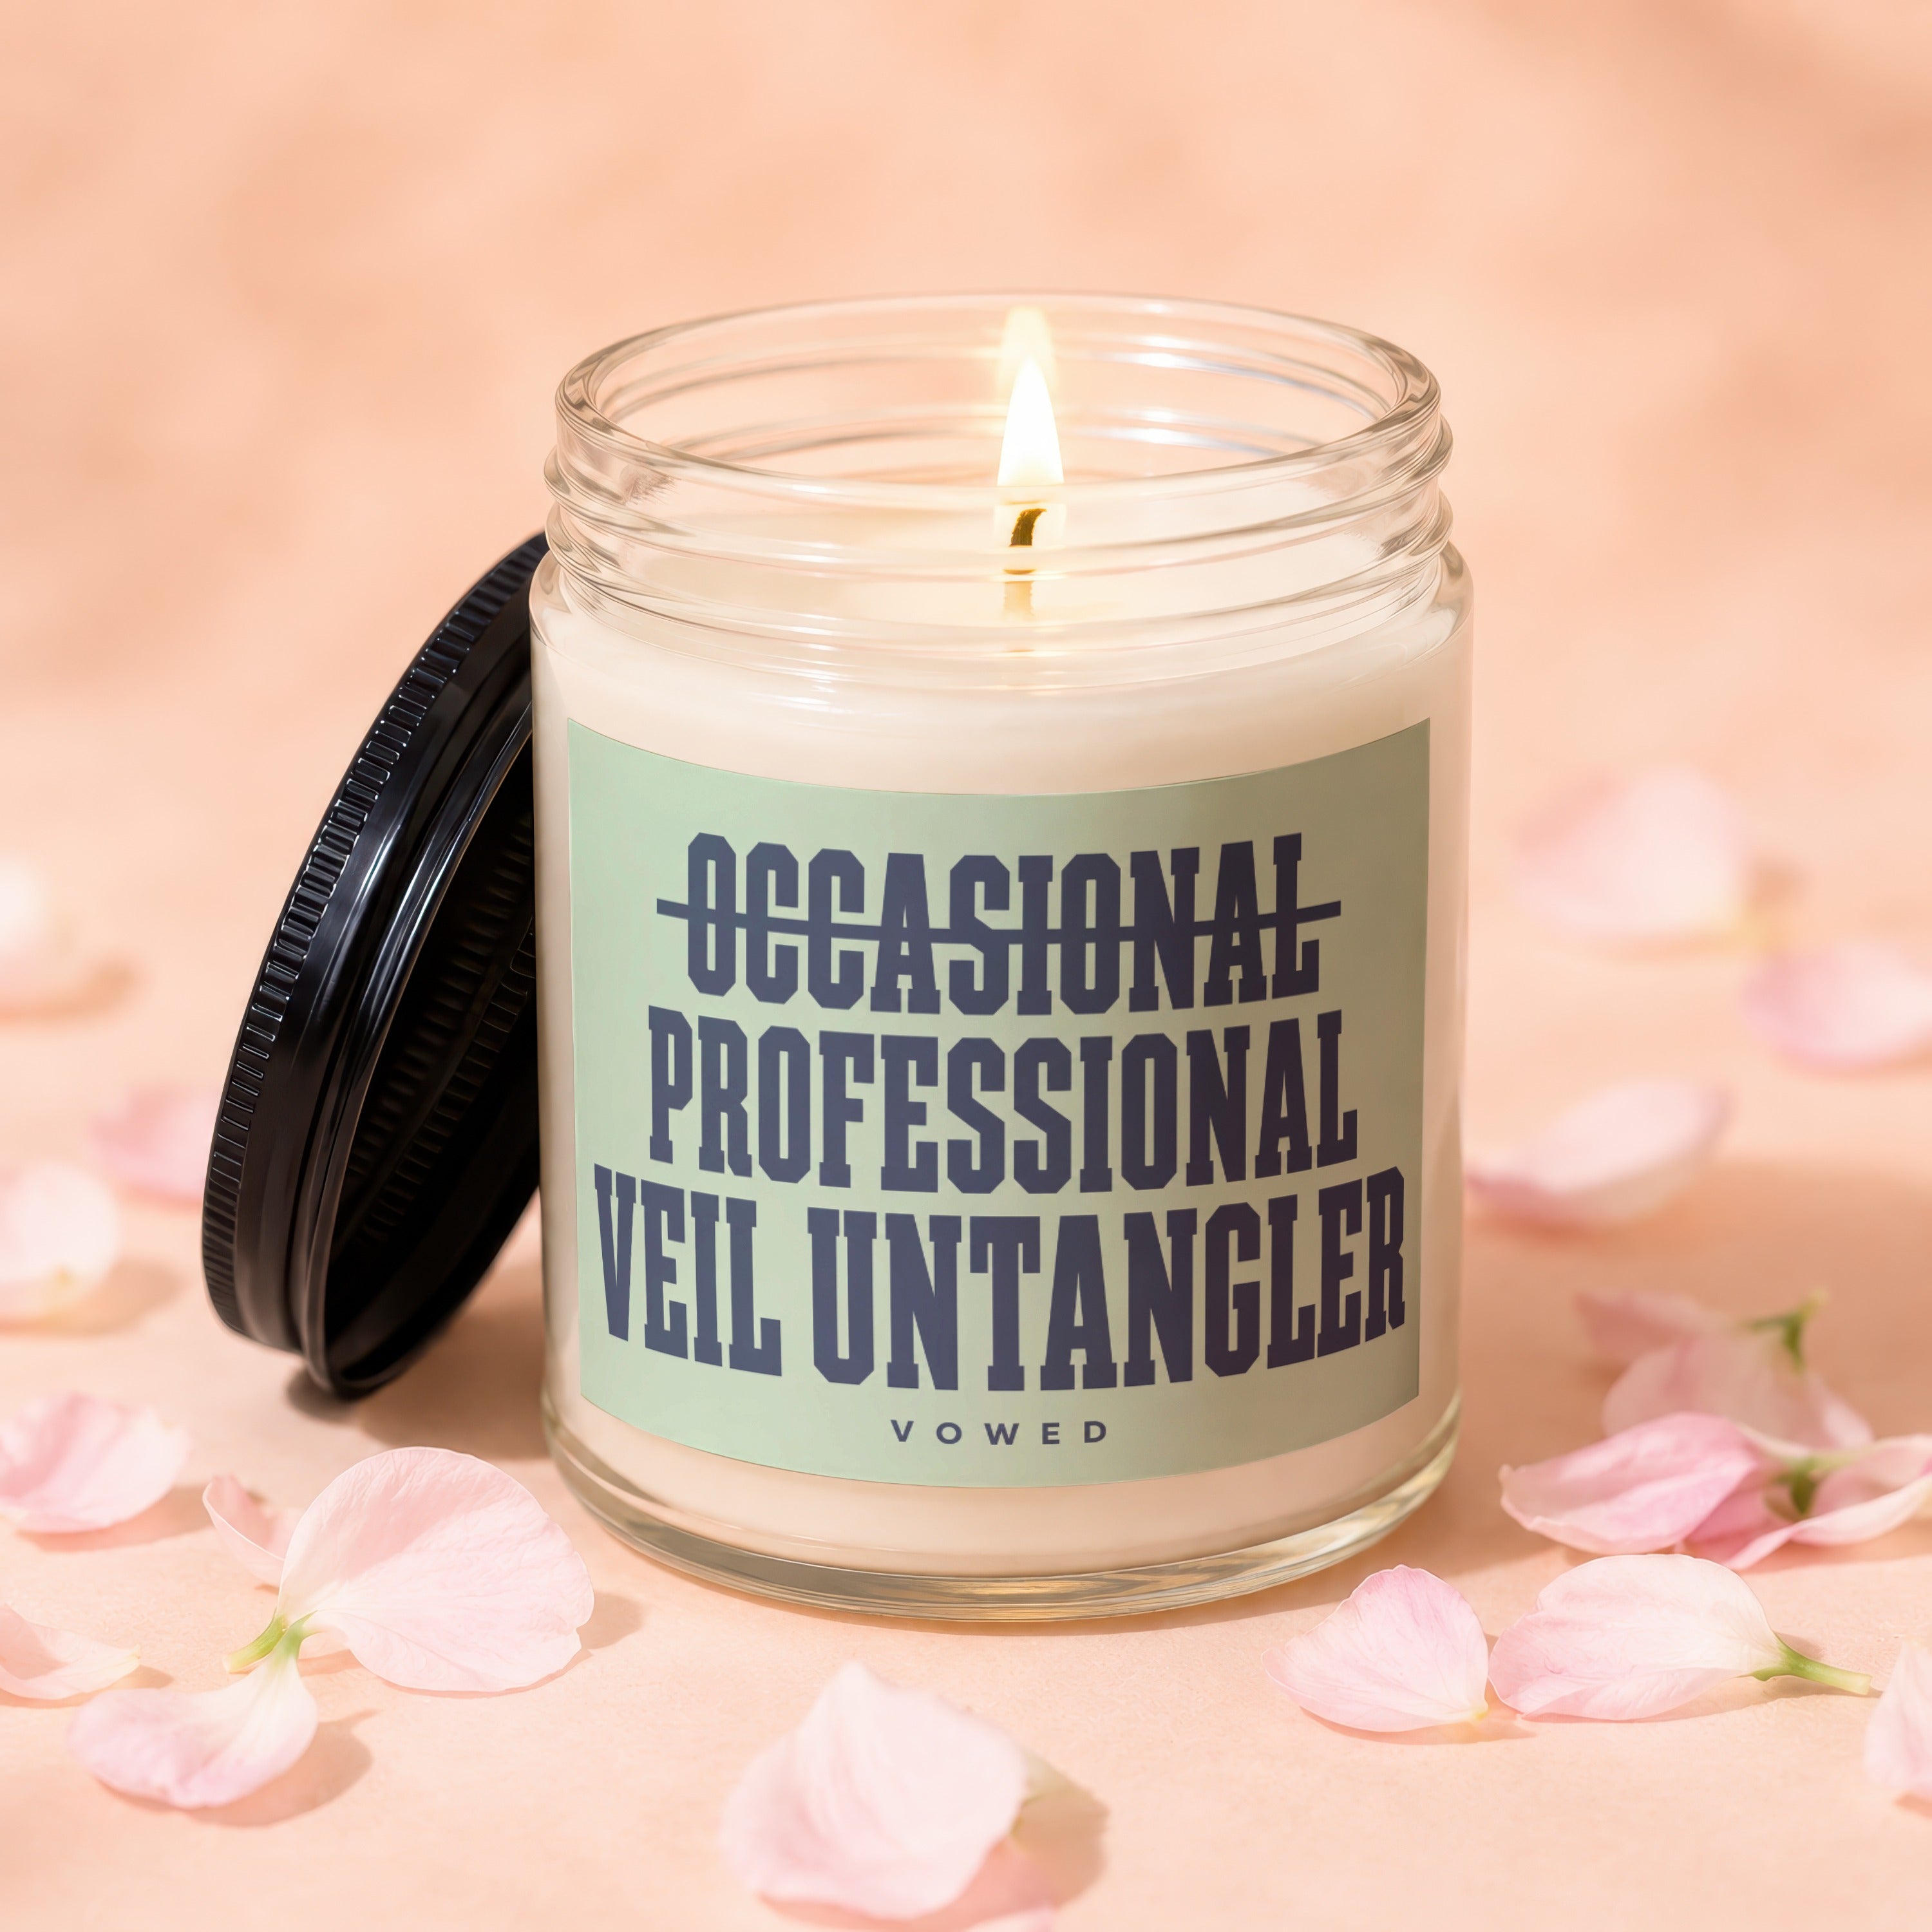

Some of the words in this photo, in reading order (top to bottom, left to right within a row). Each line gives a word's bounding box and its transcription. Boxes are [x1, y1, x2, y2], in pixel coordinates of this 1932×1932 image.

[687, 832, 1321, 1016] OCCASIONAL
[648, 1005, 1358, 1195] PROFESSIONAL
[593, 1163, 782, 1378] VEIL
[806, 1166, 1406, 1392] UNTANGLER
[890, 1419, 1107, 1445] VOWED
